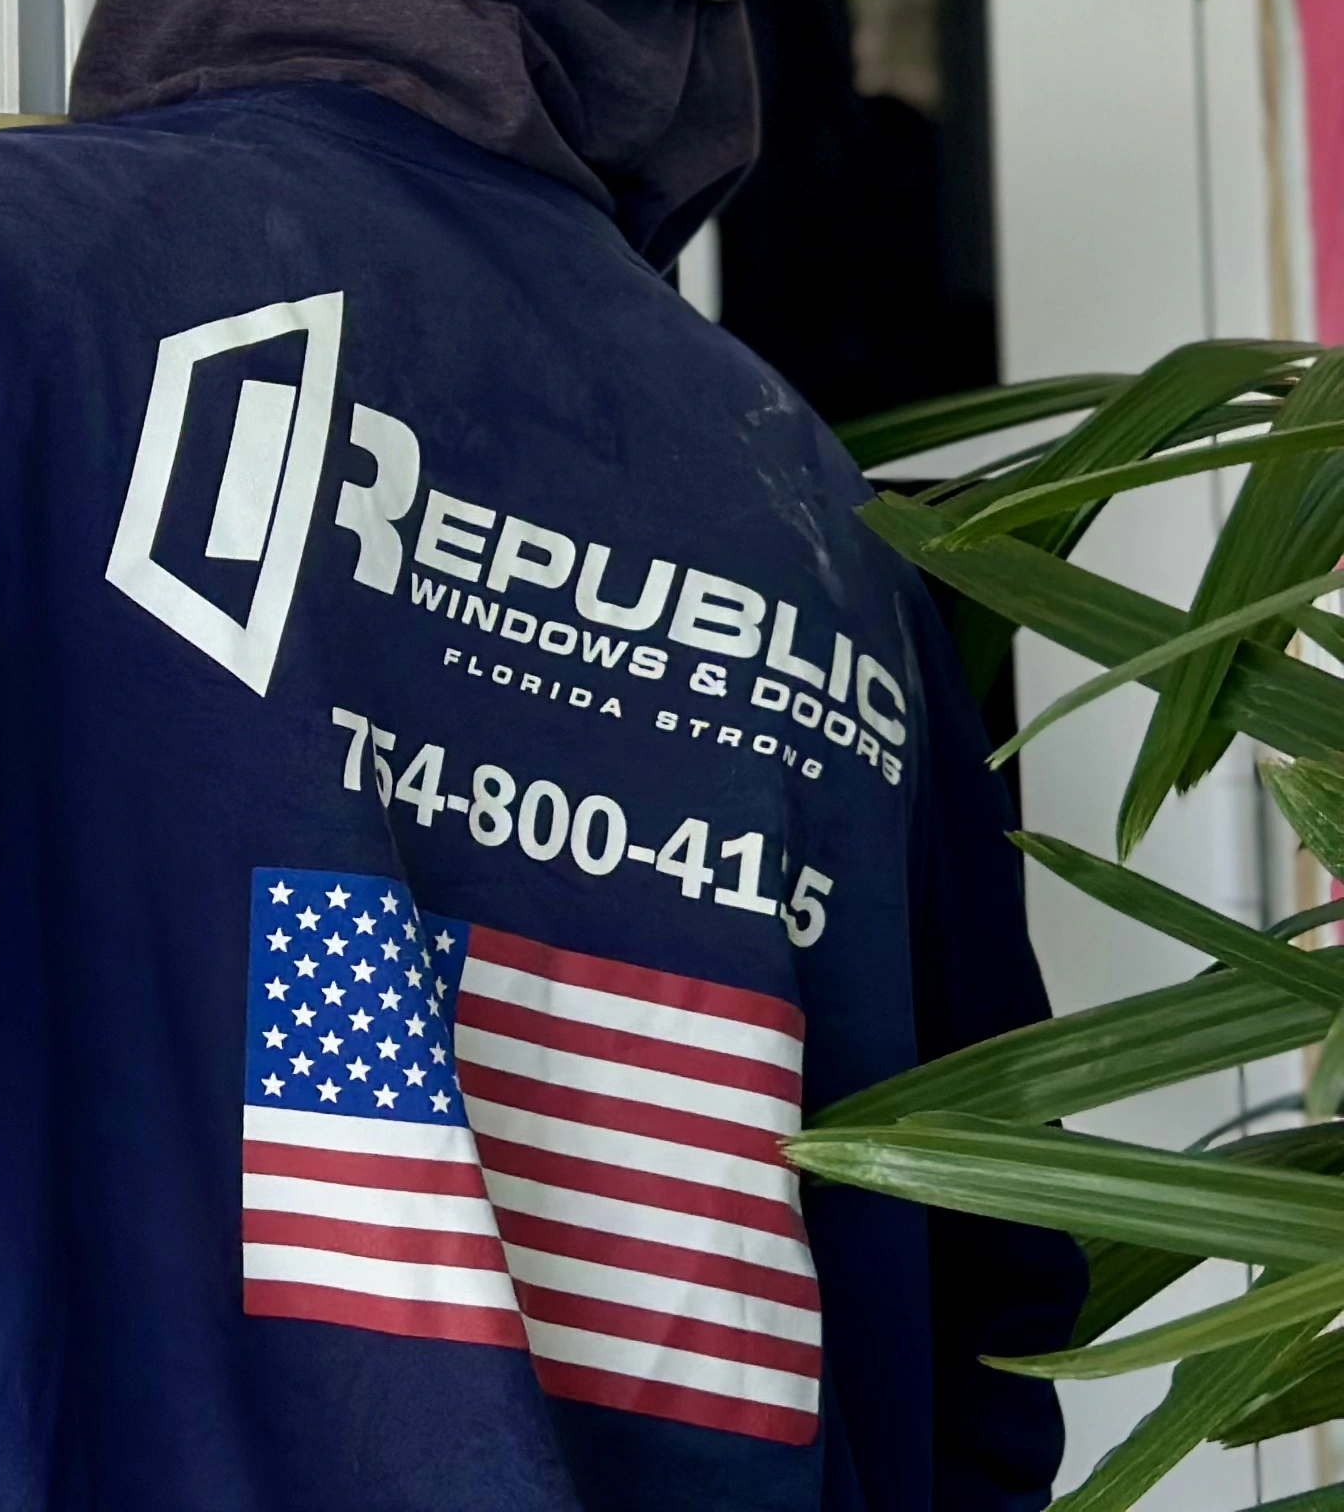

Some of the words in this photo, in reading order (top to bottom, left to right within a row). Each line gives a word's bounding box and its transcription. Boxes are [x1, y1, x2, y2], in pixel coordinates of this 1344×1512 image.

[335, 402, 906, 746] REPUBLIC
[411, 572, 669, 680] WINDOWS
[689, 662, 728, 698] &
[750, 676, 903, 786] DOORS
[332, 706, 834, 948] 754-800-415
[443, 647, 622, 718] FLORIDA
[655, 710, 823, 779] STRONG
